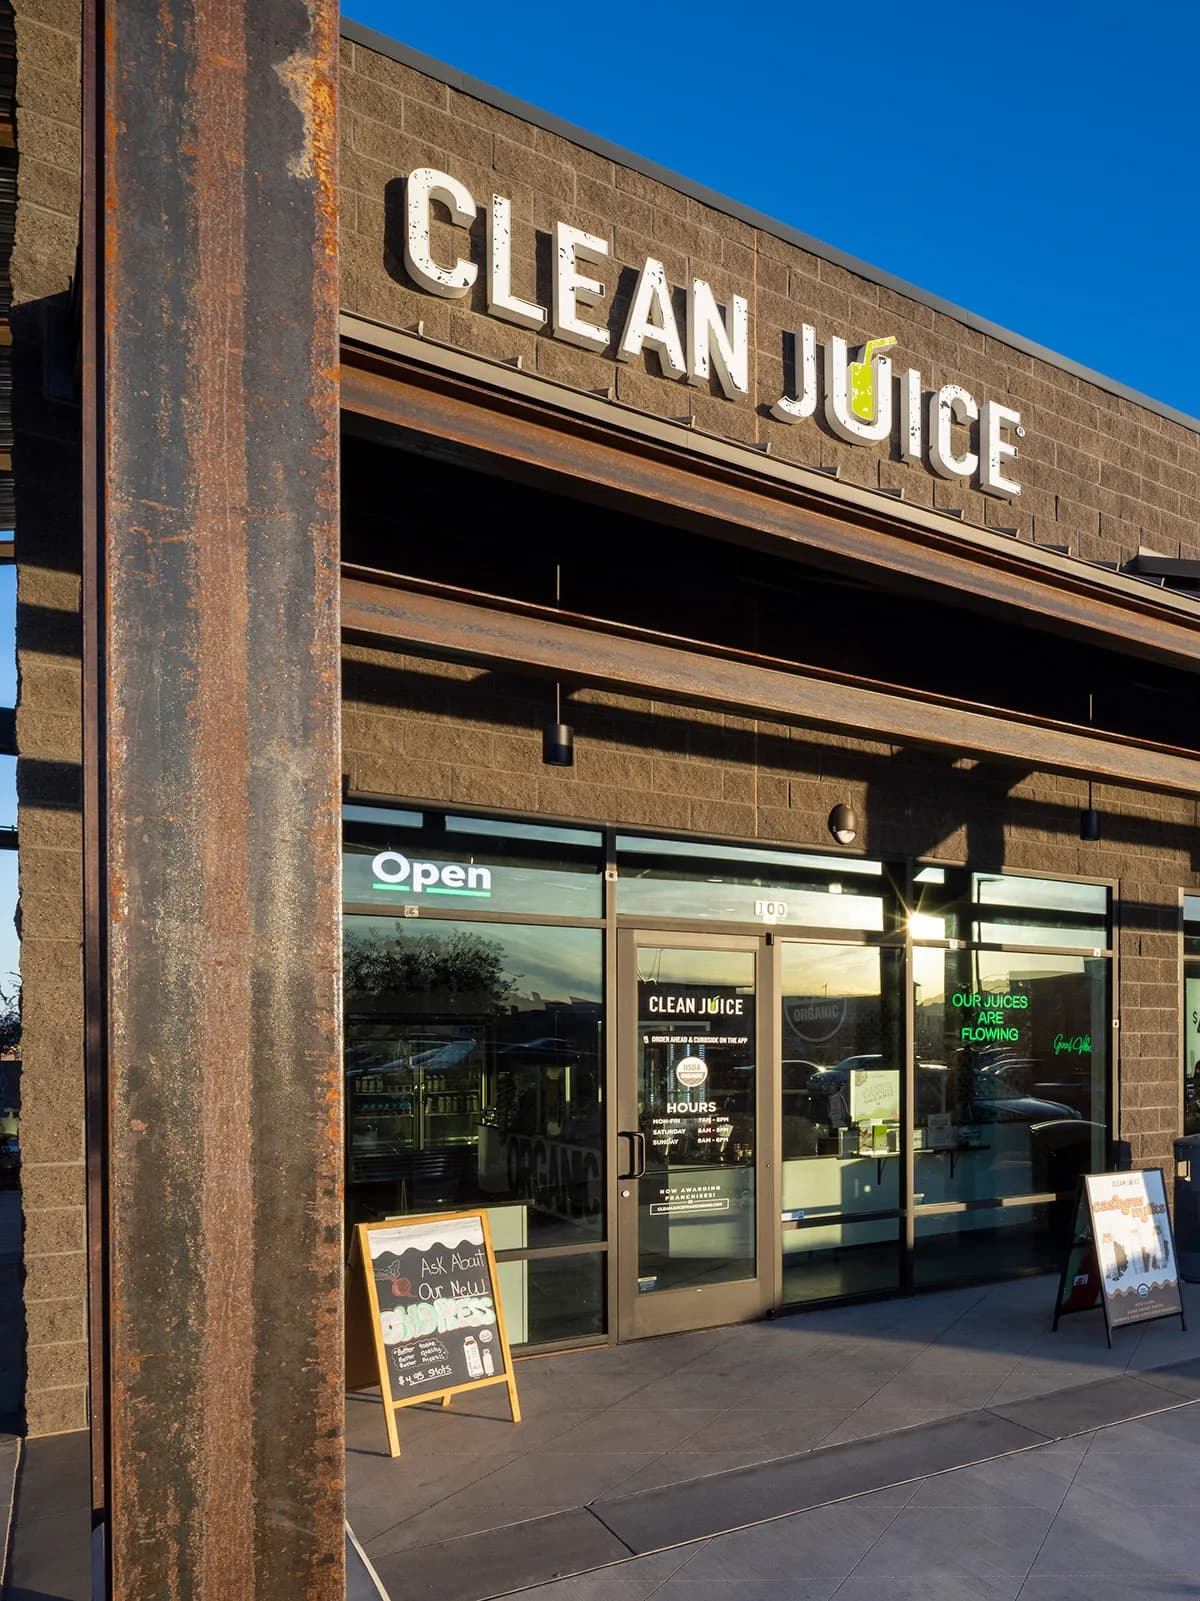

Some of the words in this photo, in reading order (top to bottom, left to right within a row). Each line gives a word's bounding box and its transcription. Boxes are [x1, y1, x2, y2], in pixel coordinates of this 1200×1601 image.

[404, 167, 749, 400] CLEAN
[770, 323, 1021, 498] JUICE
[371, 851, 492, 893] Open
[759, 902, 785, 915] 100
[649, 995, 695, 1013] CLEAN
[698, 996, 744, 1015] JUICE
[951, 993, 981, 1008] OUR
[984, 994, 1028, 1009] JUICES
[793, 1005, 840, 1022] ORGANIC
[977, 1011, 1004, 1024] ARE
[961, 1027, 1019, 1041] FLOWING
[667, 1102, 717, 1113] HOURS
[652, 1128, 686, 1136] SATURDAY
[652, 1138, 679, 1146] SUNDAY
[681, 1185, 721, 1193] AWARDING
[451, 1249, 486, 1273] About
[418, 1282, 444, 1301] Our
